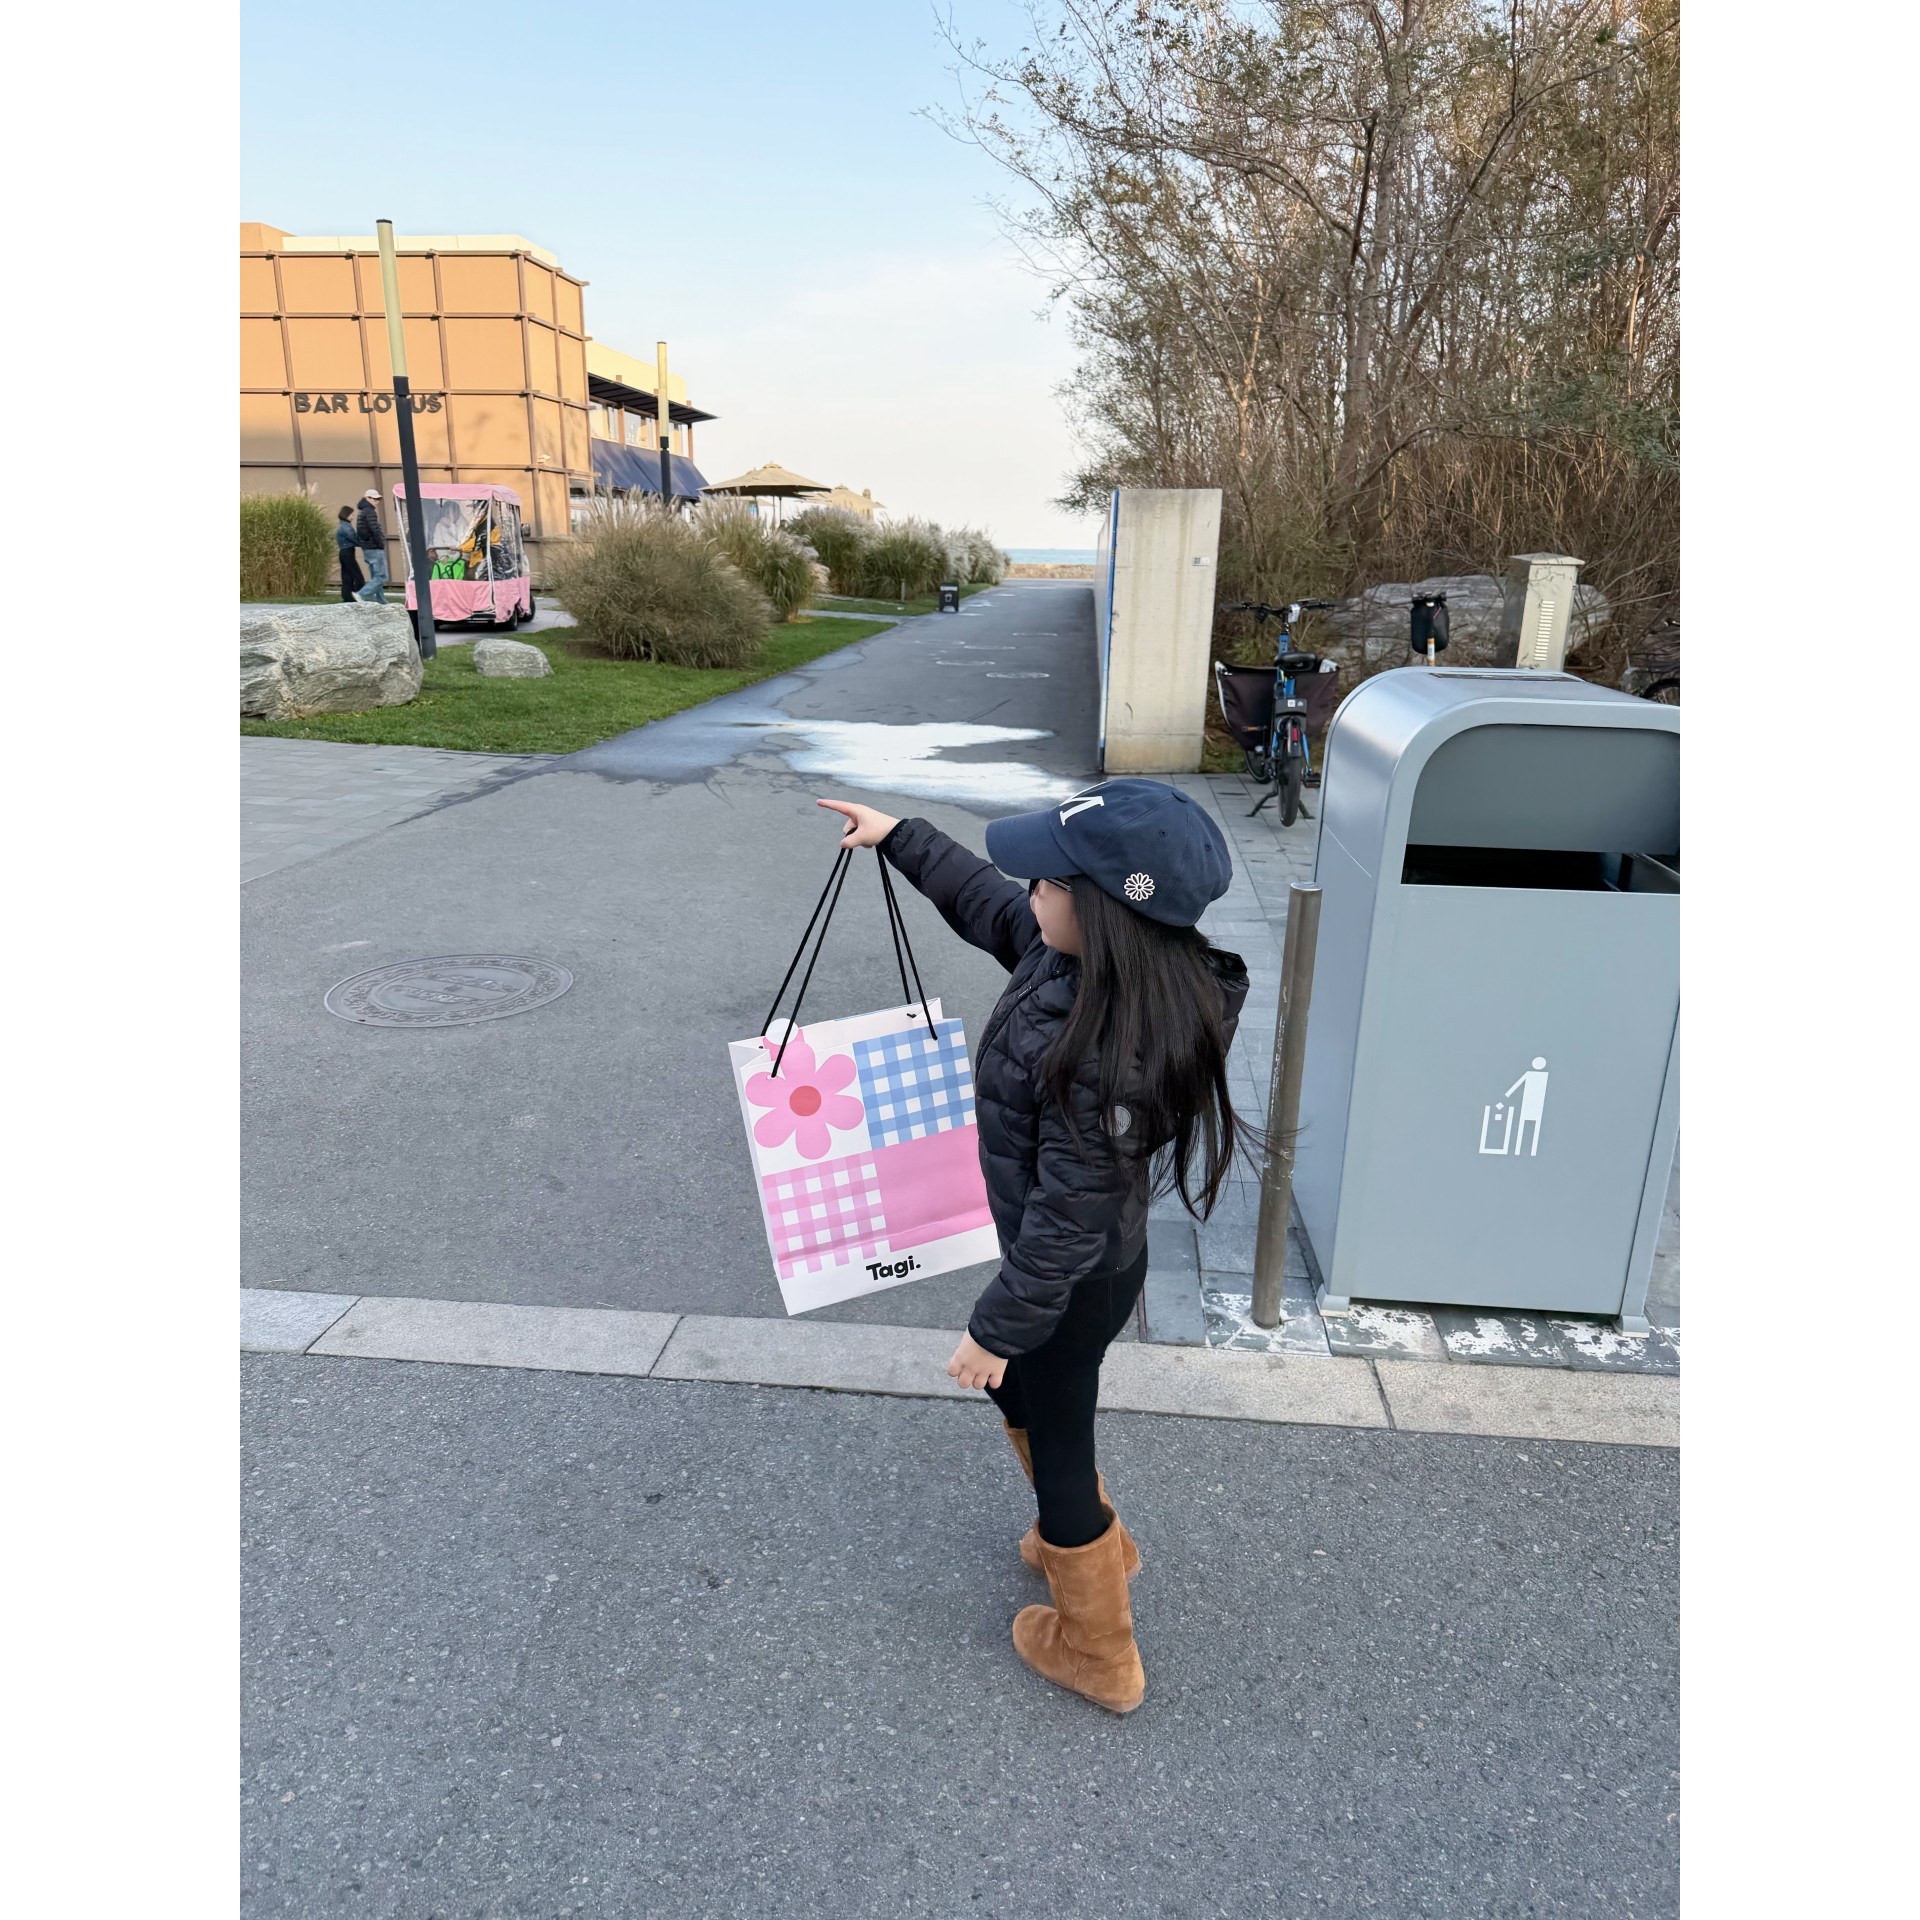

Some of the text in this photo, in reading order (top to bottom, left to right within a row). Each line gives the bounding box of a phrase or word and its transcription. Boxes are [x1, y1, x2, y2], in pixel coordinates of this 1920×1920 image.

[294, 393, 443, 414] BAR LOUS
[865, 1255, 922, 1281] Tagi.
